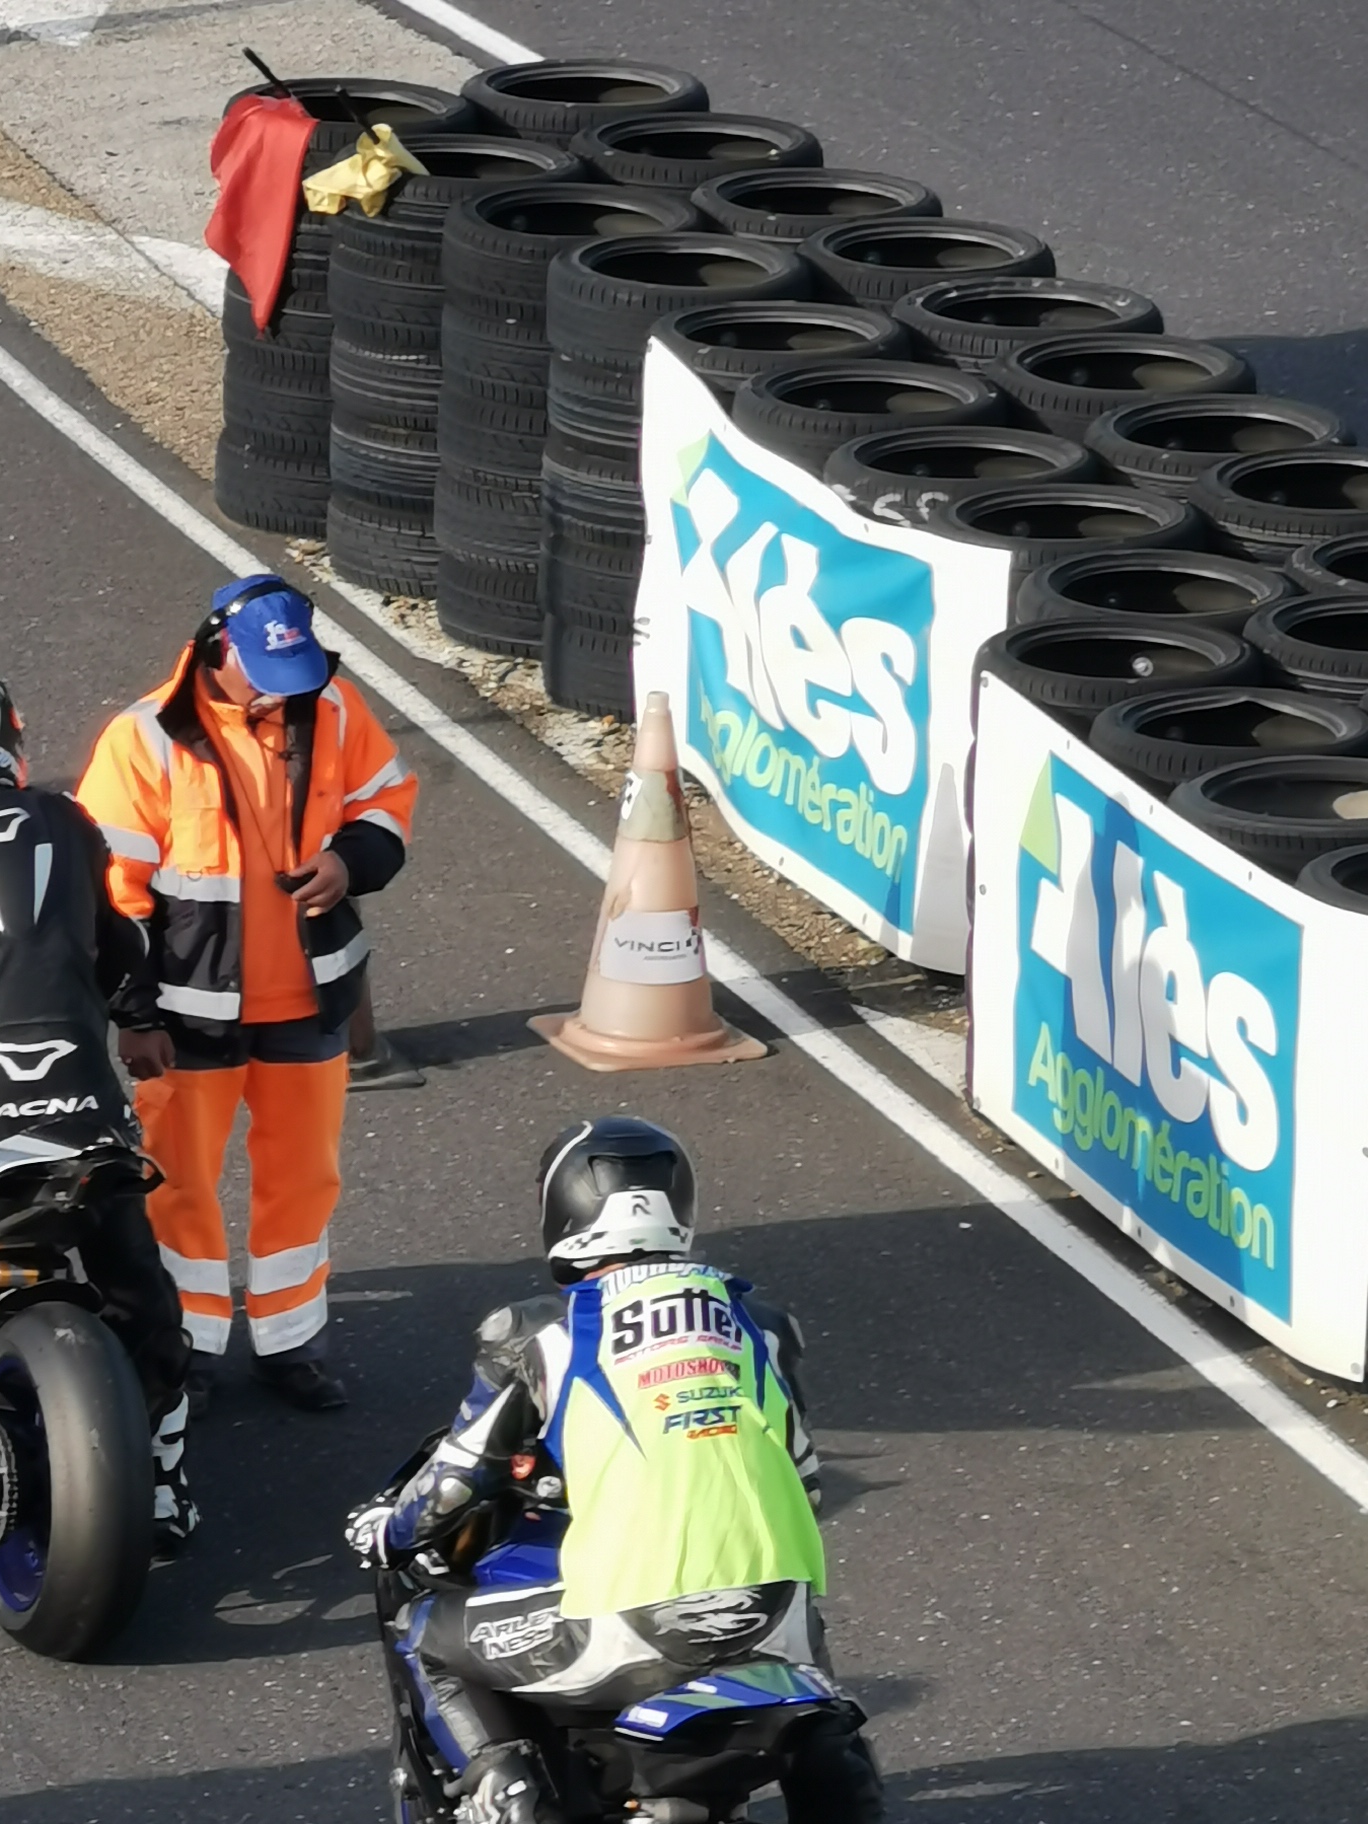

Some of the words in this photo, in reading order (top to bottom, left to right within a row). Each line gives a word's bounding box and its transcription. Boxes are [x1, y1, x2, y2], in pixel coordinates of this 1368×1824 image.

[699, 685, 908, 884] glomération
[613, 937, 680, 953] VINCI
[1030, 792, 1279, 1172] Alès
[1027, 1020, 1275, 1271] Agglomération
[662, 1405, 742, 1435] FIRST
[675, 1386, 742, 1403] SUZUK
